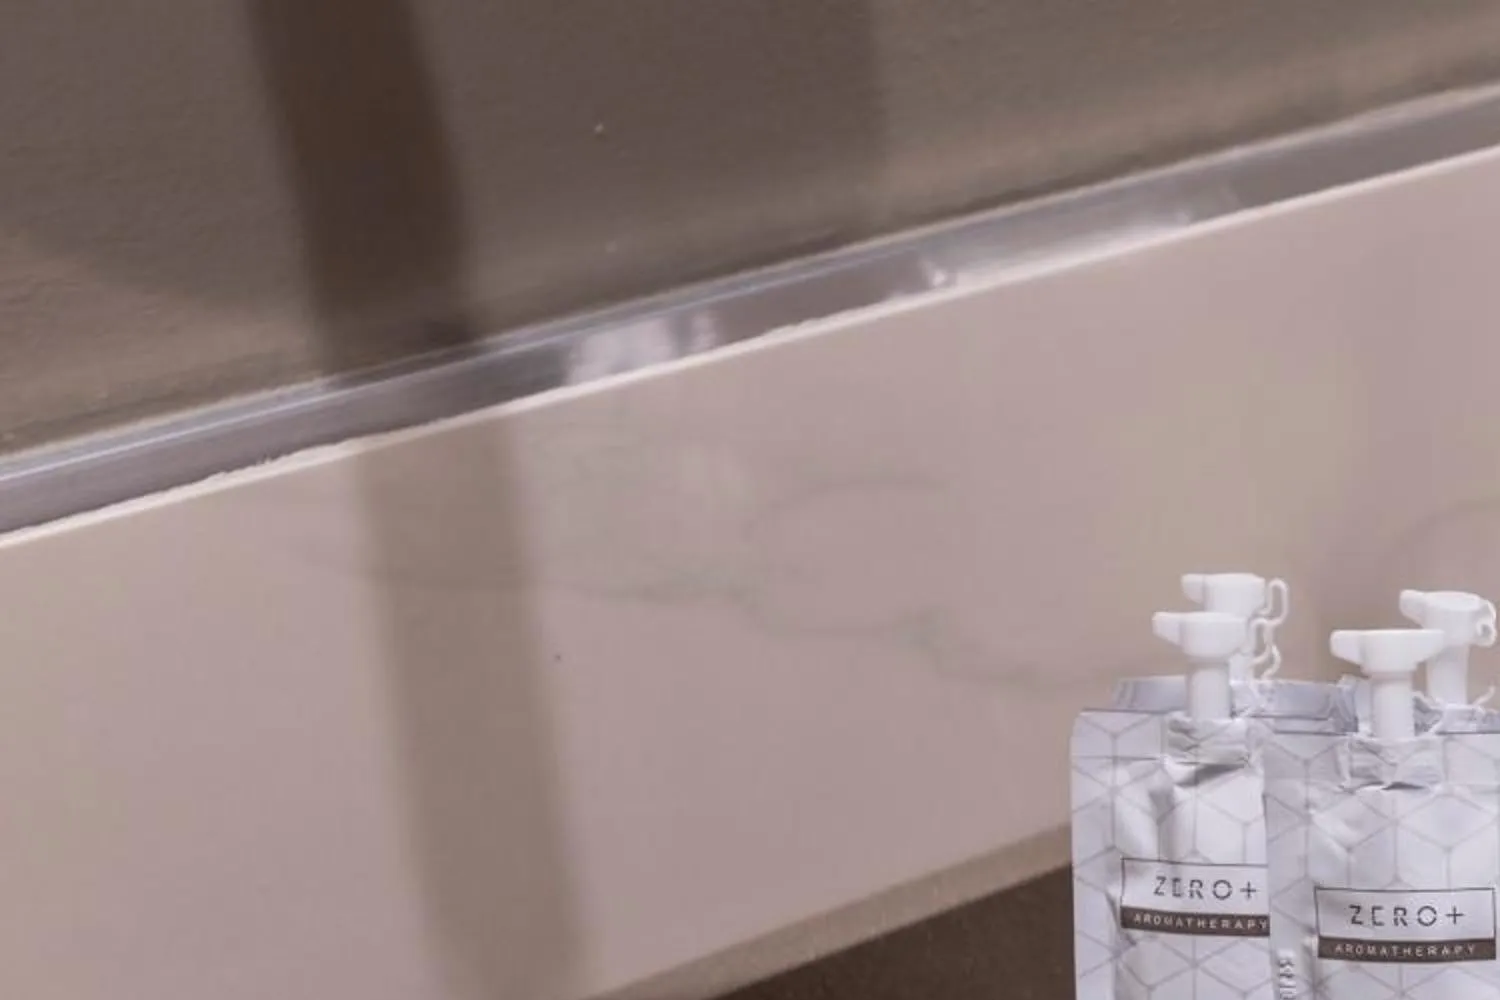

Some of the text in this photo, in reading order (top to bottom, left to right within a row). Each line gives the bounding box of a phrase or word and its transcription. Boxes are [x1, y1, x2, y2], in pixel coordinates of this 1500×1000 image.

[1153, 875, 1257, 901] ZERO+
[1133, 912, 1268, 930] AROMATHERAPY
[1349, 904, 1465, 927] ZERO+
[1335, 943, 1477, 958] AROMATHERAPY
